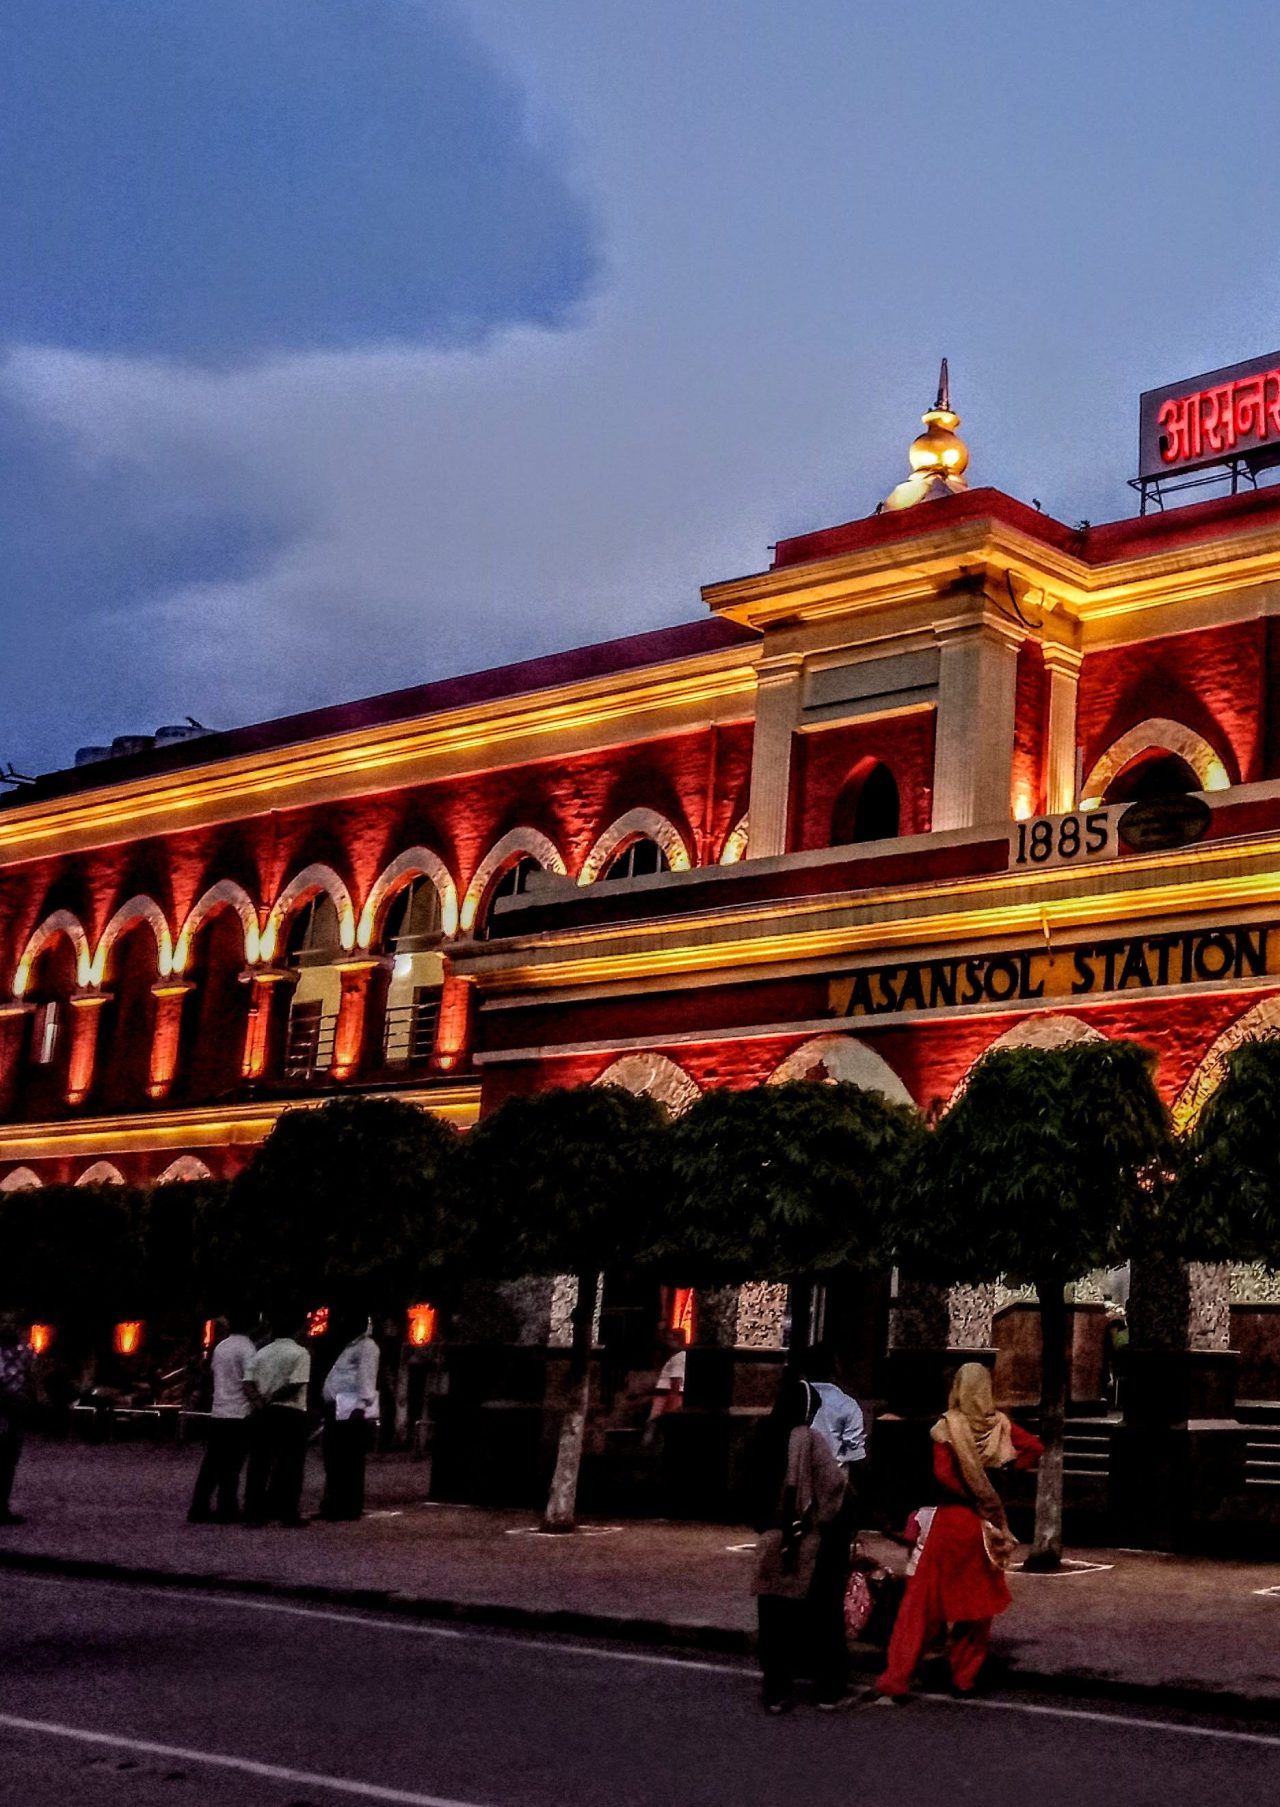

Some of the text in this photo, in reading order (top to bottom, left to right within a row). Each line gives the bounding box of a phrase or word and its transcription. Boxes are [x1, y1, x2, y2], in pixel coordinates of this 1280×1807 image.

[1016, 813, 1107, 864] 1885
[844, 928, 1268, 1018] ASANSOL STATION
